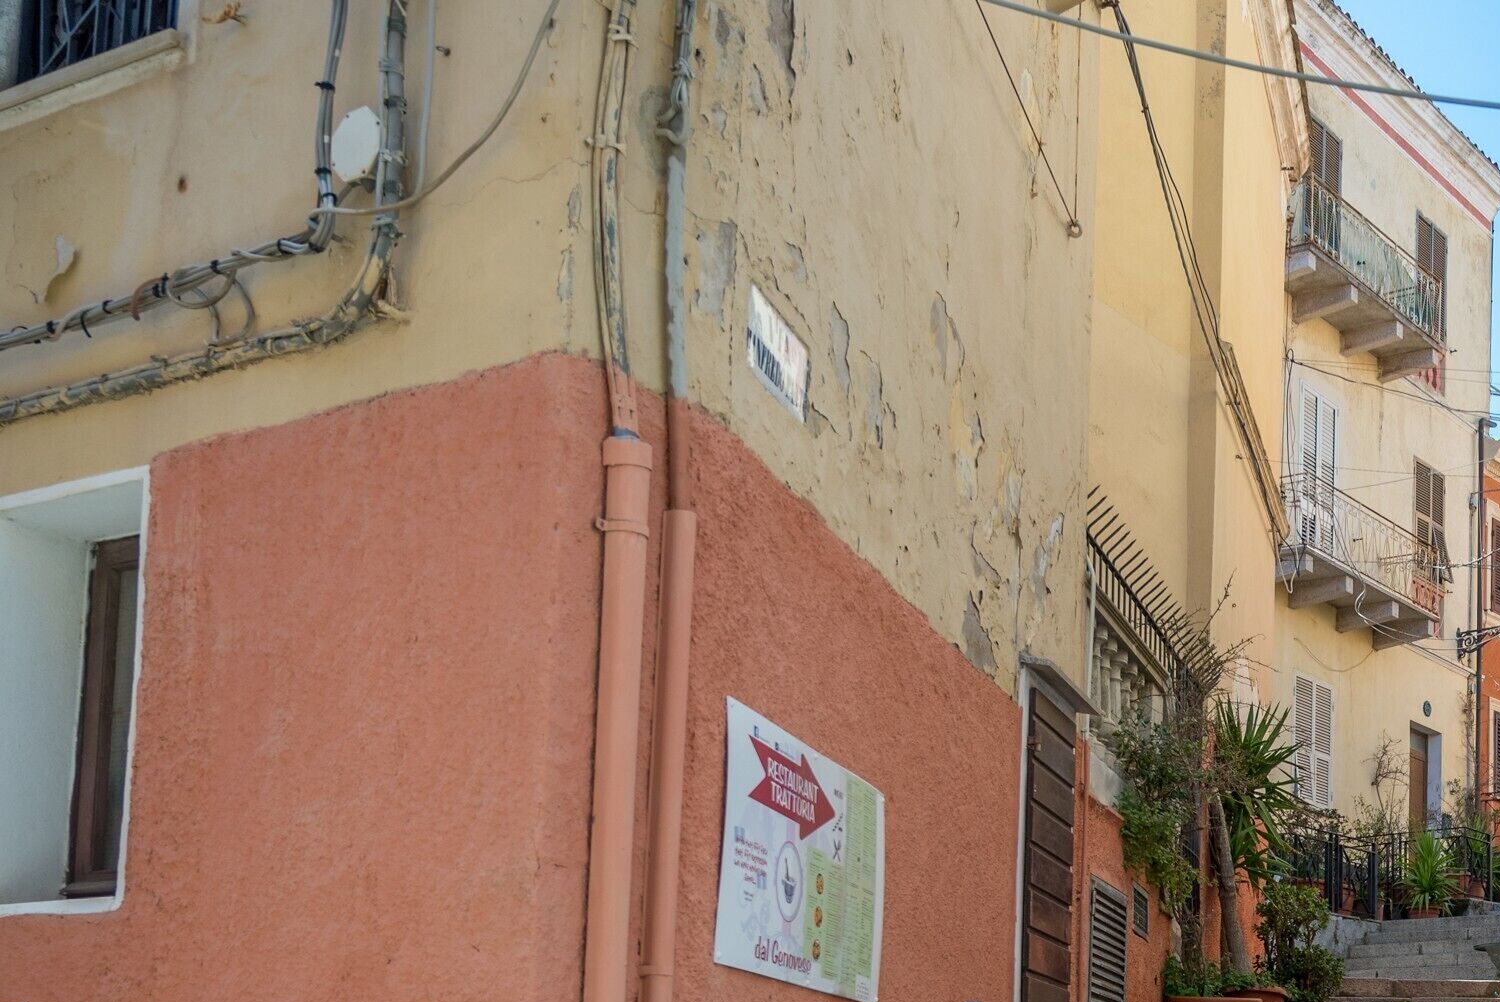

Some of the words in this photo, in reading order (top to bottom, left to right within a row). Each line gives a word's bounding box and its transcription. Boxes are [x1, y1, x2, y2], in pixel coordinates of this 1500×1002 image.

[767, 756, 819, 804] RESTAURANT
[770, 780, 816, 824] TRATTORIA
[754, 935, 770, 962] dal
[771, 939, 812, 975] Genovese
